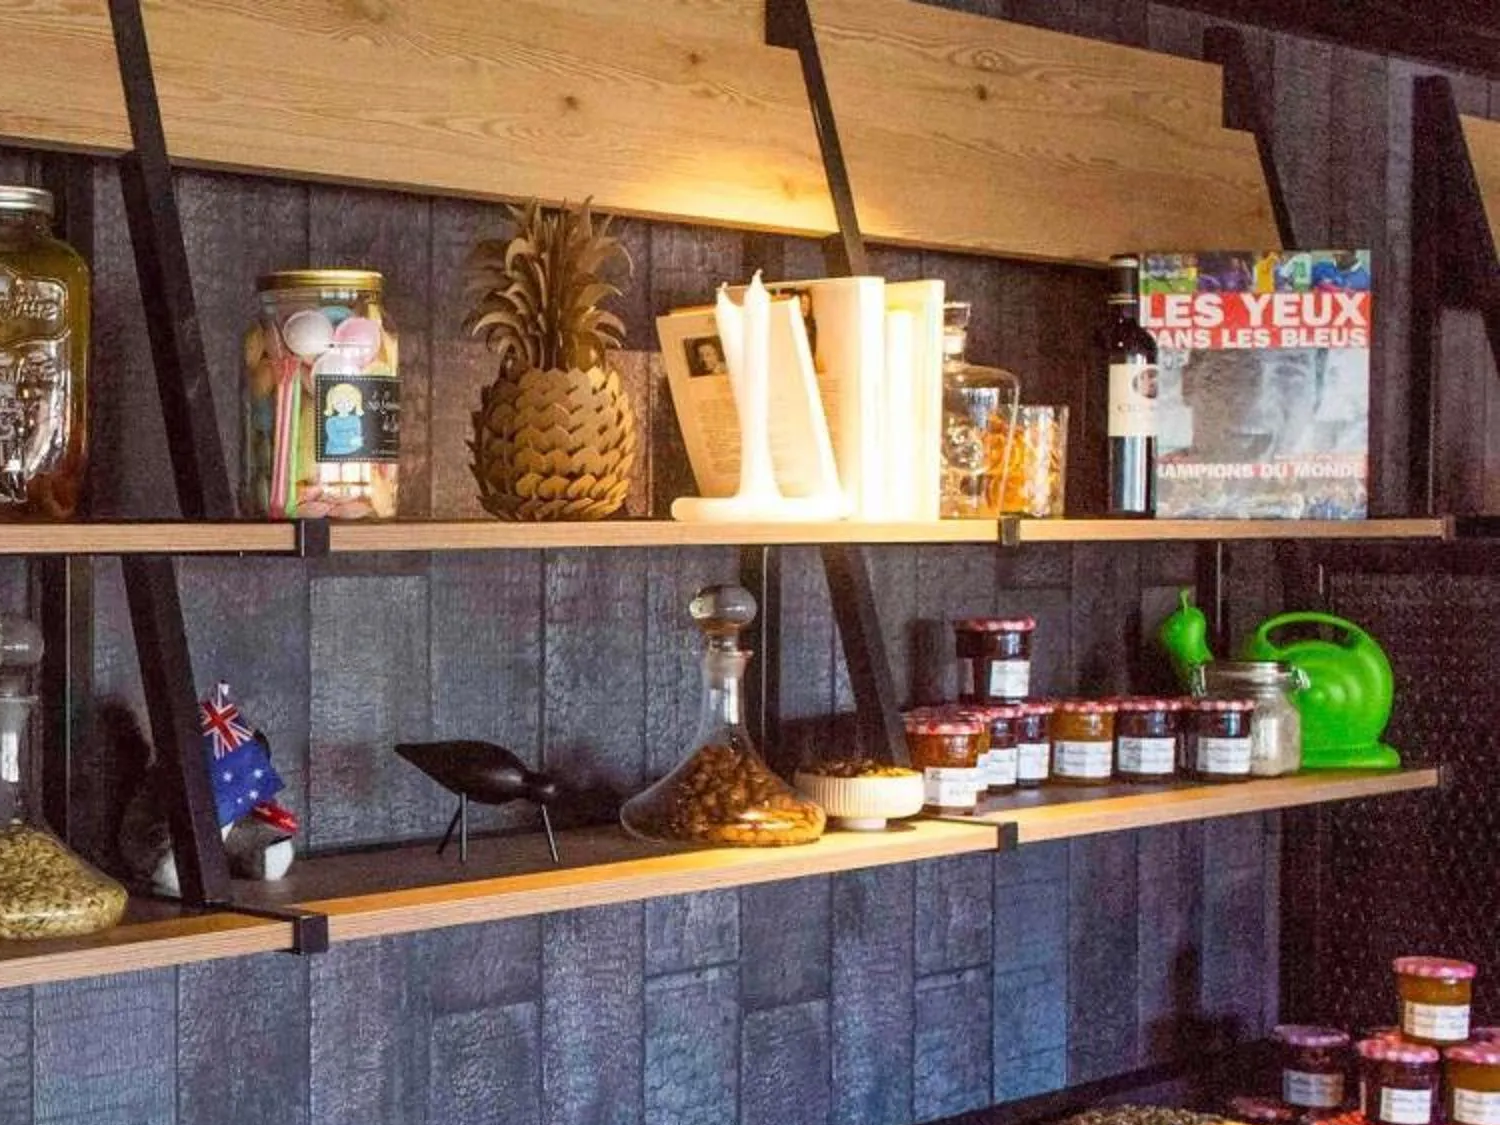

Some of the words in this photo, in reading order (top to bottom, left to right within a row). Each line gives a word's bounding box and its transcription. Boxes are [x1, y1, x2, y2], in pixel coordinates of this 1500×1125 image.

[1140, 293, 1225, 328] LES
[1241, 292, 1368, 328] YEUX
[1222, 328, 1271, 349] LES
[1281, 327, 1367, 349] BLEUS
[1260, 462, 1288, 479] DU
[1294, 462, 1366, 479] MONDE
